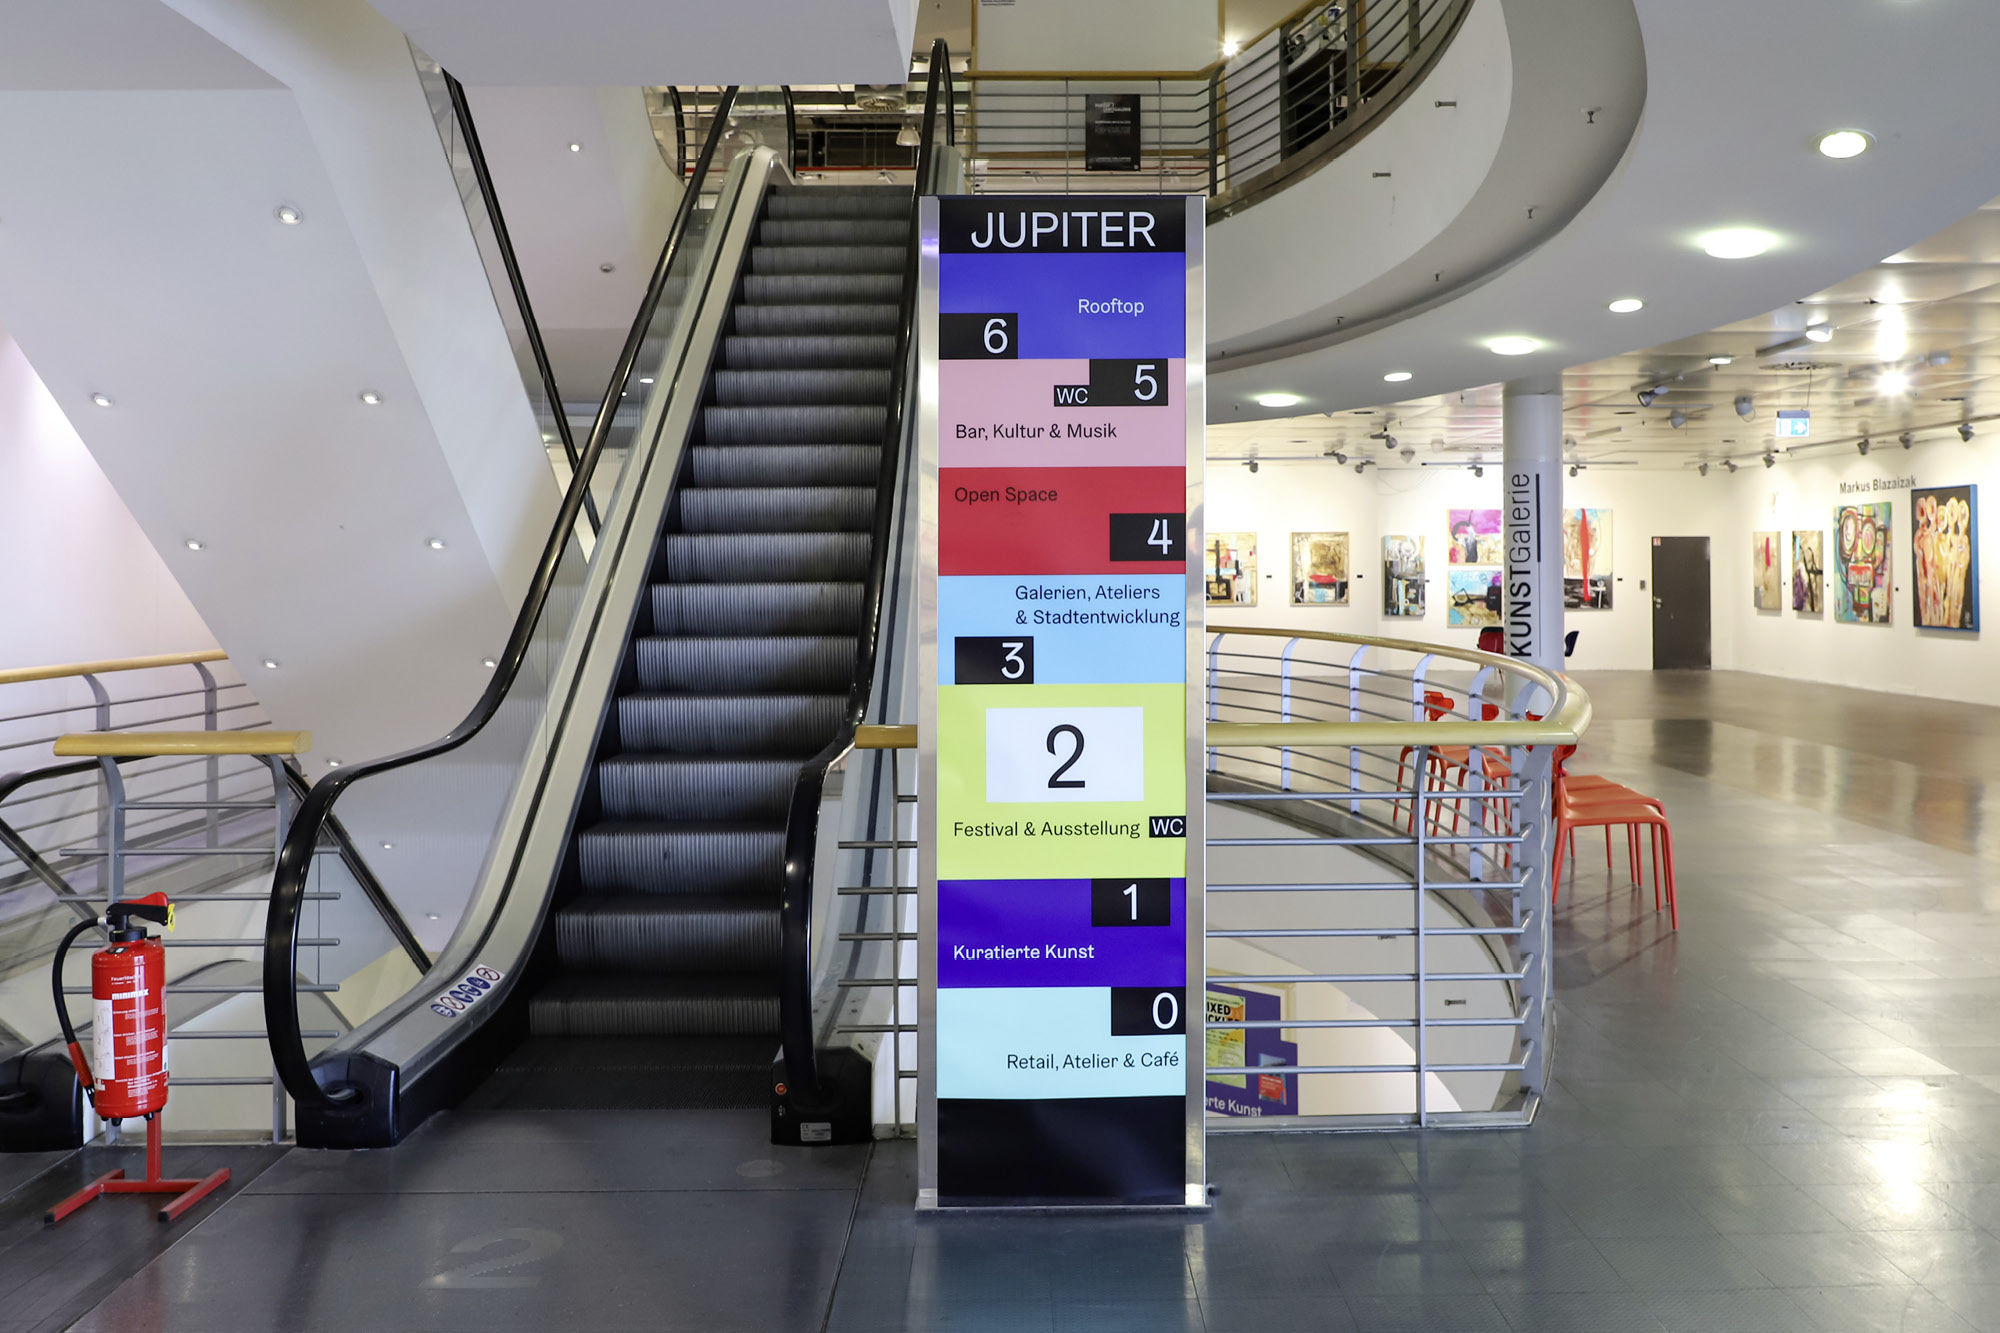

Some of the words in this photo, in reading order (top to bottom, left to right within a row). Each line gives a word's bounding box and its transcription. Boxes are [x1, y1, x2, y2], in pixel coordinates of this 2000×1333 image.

[971, 212, 1155, 248] JUPITER
[1079, 298, 1144, 316] Rooftop
[984, 319, 1008, 353] 6
[1135, 365, 1157, 400] 5
[1057, 388, 1088, 404] WC
[956, 424, 988, 440] Bar,
[994, 424, 1044, 438] Kultur
[1050, 424, 1061, 438] &
[1068, 423, 1117, 438] Musik
[1840, 481, 1871, 495] Markus
[1873, 474, 1915, 491] Blazaizak
[955, 487, 999, 505] Open
[1006, 487, 1057, 505] Space
[1148, 519, 1172, 554] 4
[1508, 473, 1532, 657] KUNSTGalerie
[1016, 585, 1090, 601] Galerien,
[1095, 585, 1160, 599] Ateliers
[1016, 610, 1027, 624] &
[1034, 609, 1180, 627] Stadtentwicklung
[1002, 642, 1024, 678] 3
[1047, 724, 1085, 788] 2
[955, 822, 1017, 836] Festival
[1024, 822, 1036, 836] &
[1041, 821, 1140, 839] Ausstellung
[1152, 819, 1183, 835] WC
[1123, 884, 1137, 920] 1
[954, 945, 1040, 960] Kuratierte
[1046, 944, 1094, 958] Kunst
[1153, 992, 1178, 1029] 0
[1207, 1002, 1231, 1016] IXED
[1008, 1054, 1058, 1071] Retail,
[1063, 1054, 1118, 1068] Atelier
[1123, 1053, 1135, 1067] &
[1141, 1051, 1178, 1067] Café
[1228, 1099, 1262, 1116] Kunst
